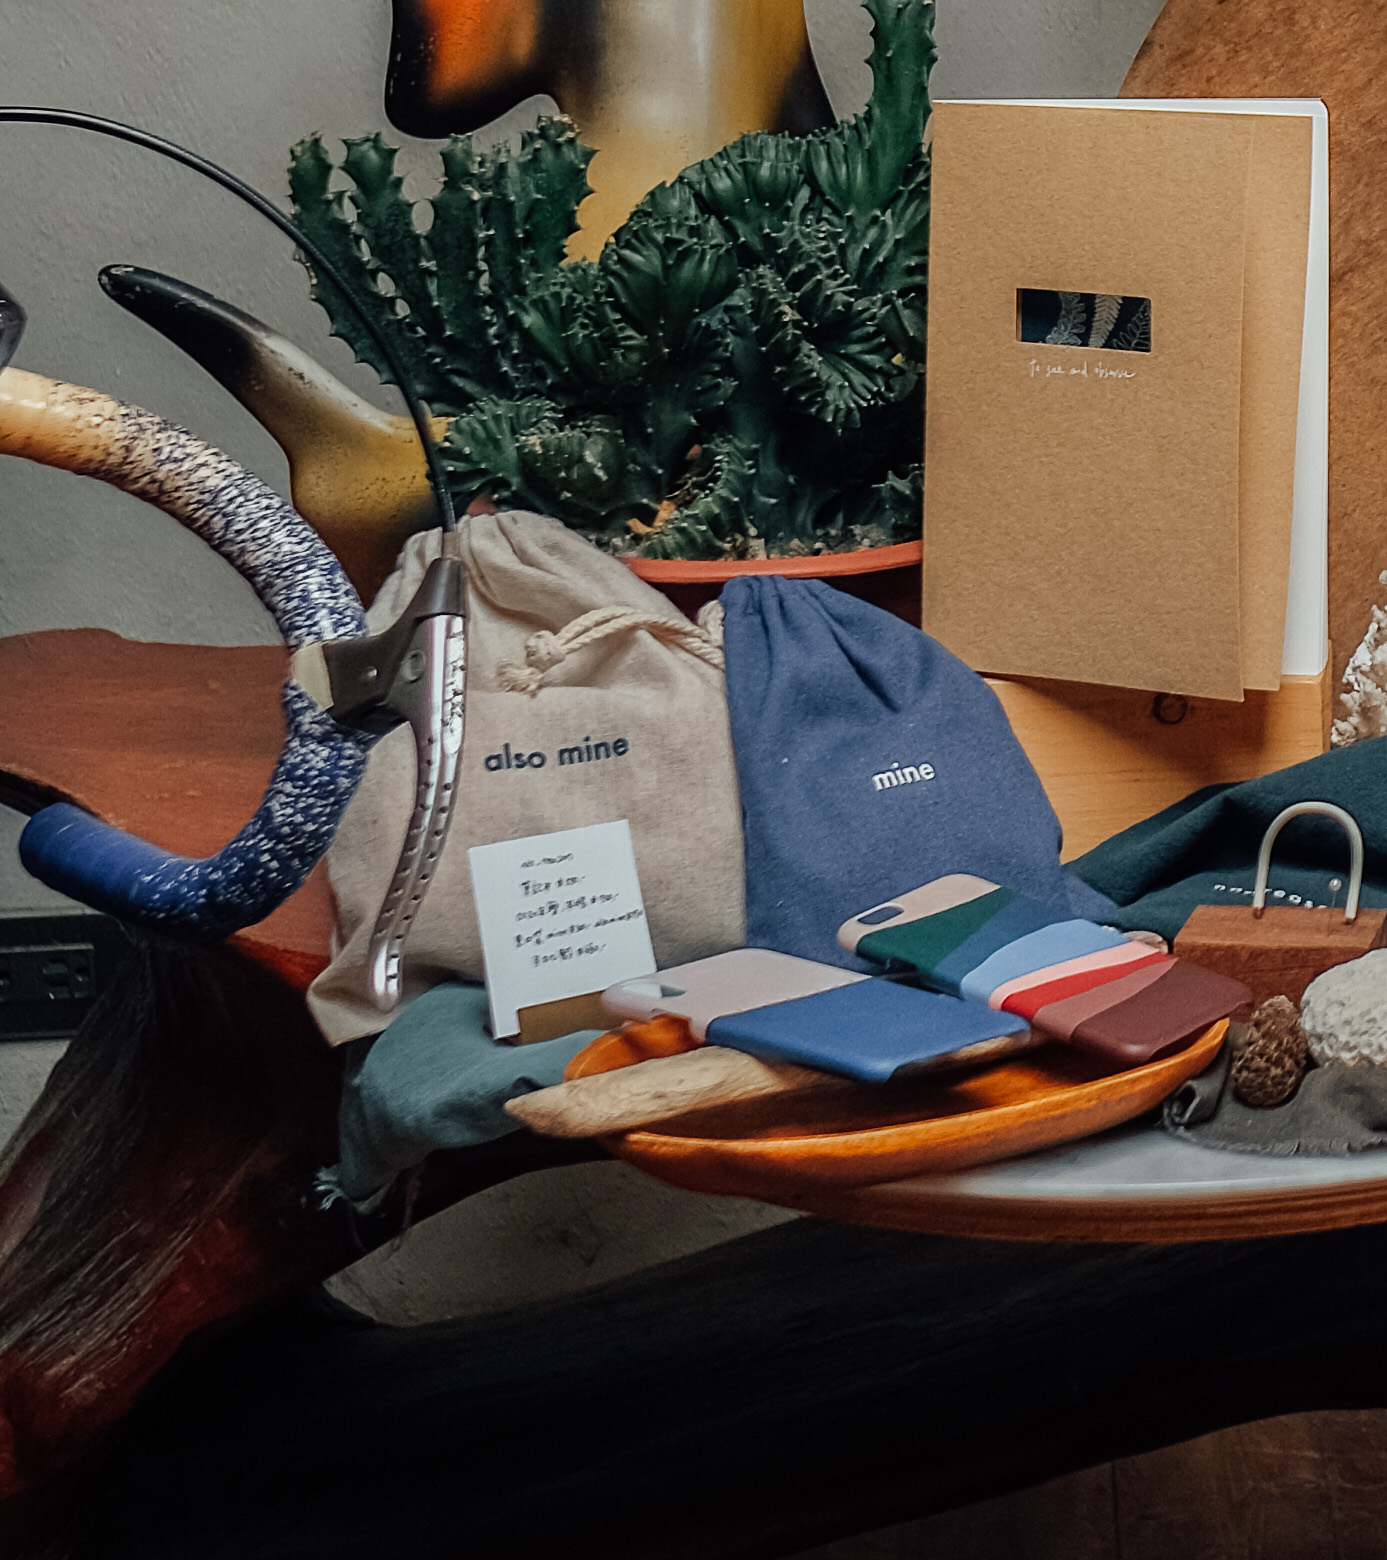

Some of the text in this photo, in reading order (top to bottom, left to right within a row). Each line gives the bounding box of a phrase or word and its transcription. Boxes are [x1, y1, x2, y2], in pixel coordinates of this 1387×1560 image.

[483, 735, 630, 773] also mine
[871, 760, 937, 792] mine
